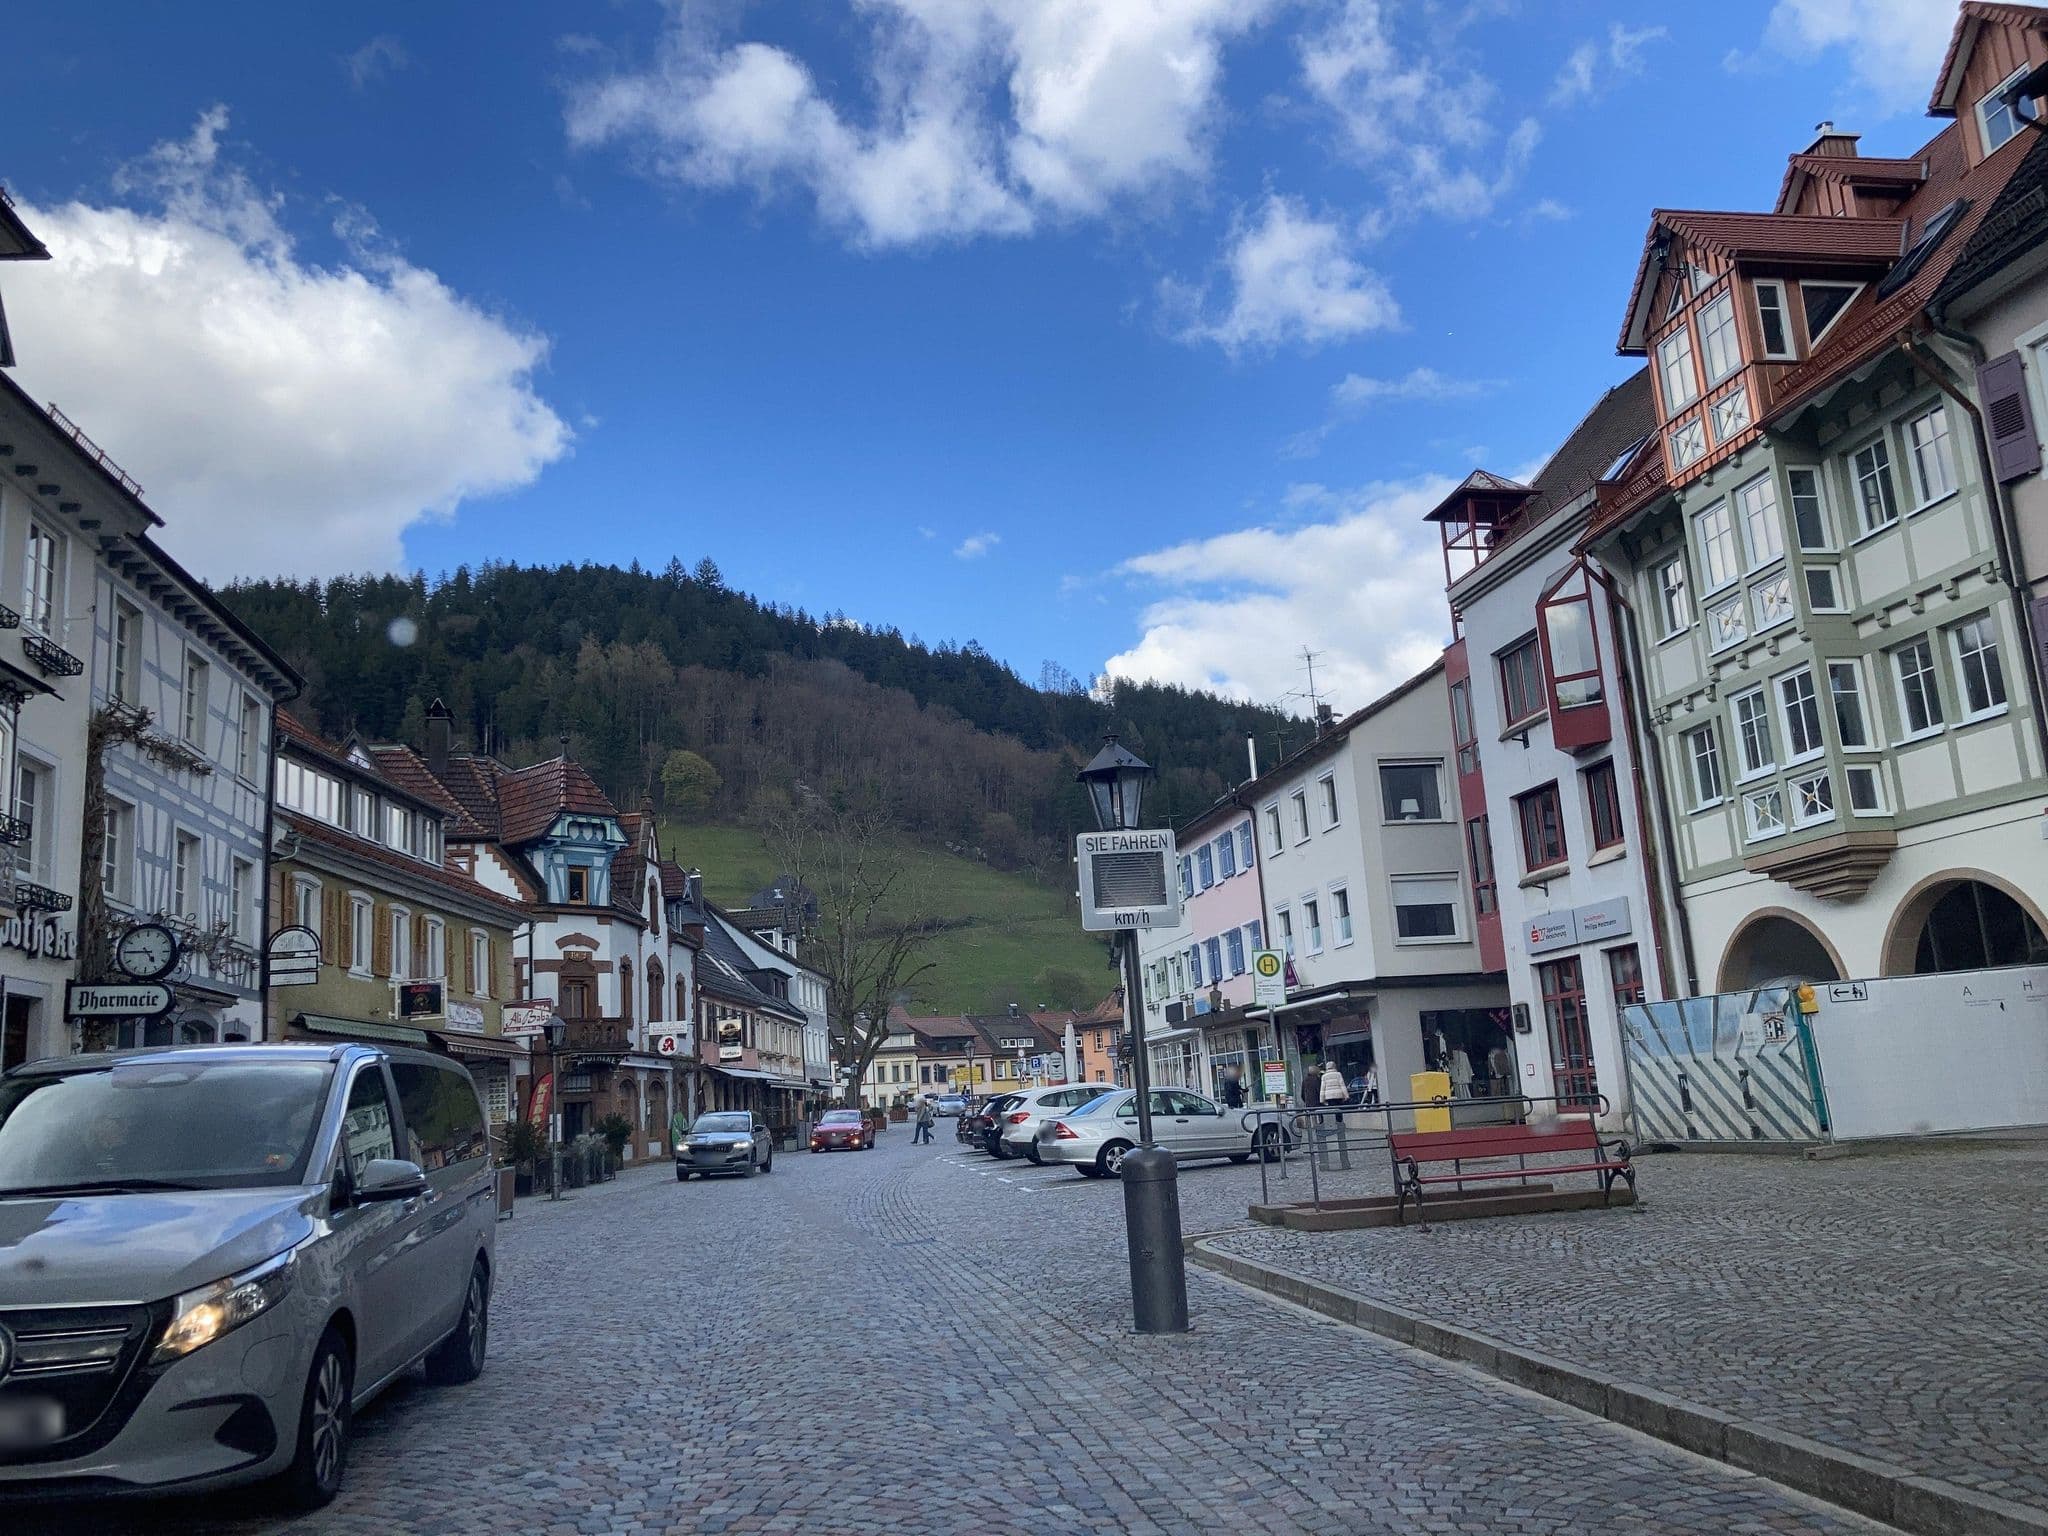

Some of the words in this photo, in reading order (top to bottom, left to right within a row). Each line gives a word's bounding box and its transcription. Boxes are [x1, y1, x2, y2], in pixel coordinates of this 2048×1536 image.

[1085, 836, 1108, 852] SIE
[1112, 833, 1169, 850] FAHREN
[1114, 910, 1150, 925] km/h
[1263, 958, 1274, 972] H
[78, 990, 159, 1010] Pharmacie
